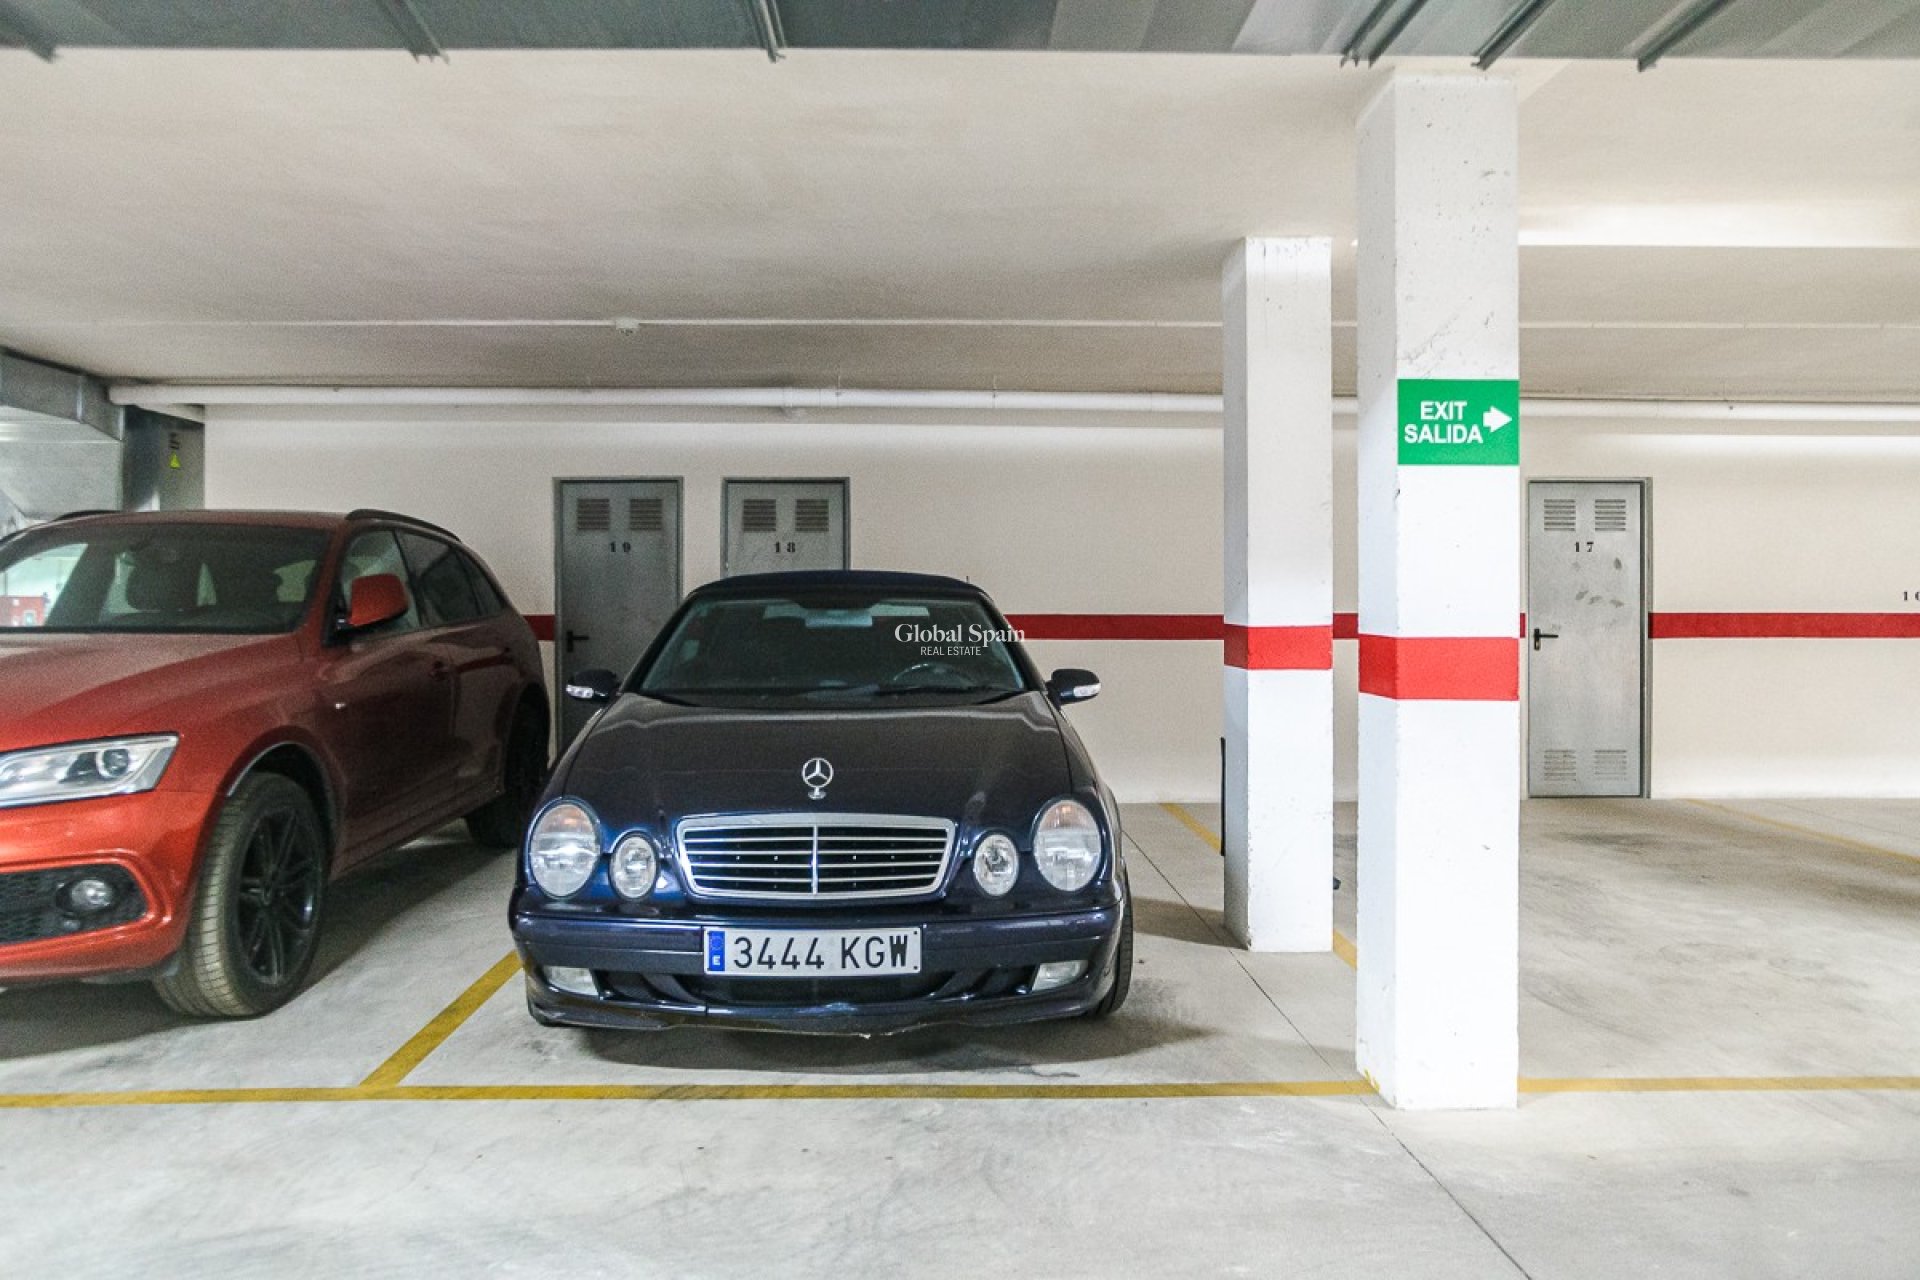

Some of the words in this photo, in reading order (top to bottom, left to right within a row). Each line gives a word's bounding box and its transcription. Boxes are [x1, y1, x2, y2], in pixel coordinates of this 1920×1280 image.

[1420, 401, 1467, 420] EXIT
[1404, 423, 1484, 444] SALIDA
[609, 541, 631, 553] 19
[774, 541, 796, 553] 18
[1574, 541, 1594, 553] 17
[712, 956, 721, 966] E
[733, 937, 825, 970] 3444
[841, 935, 908, 969] KGW
